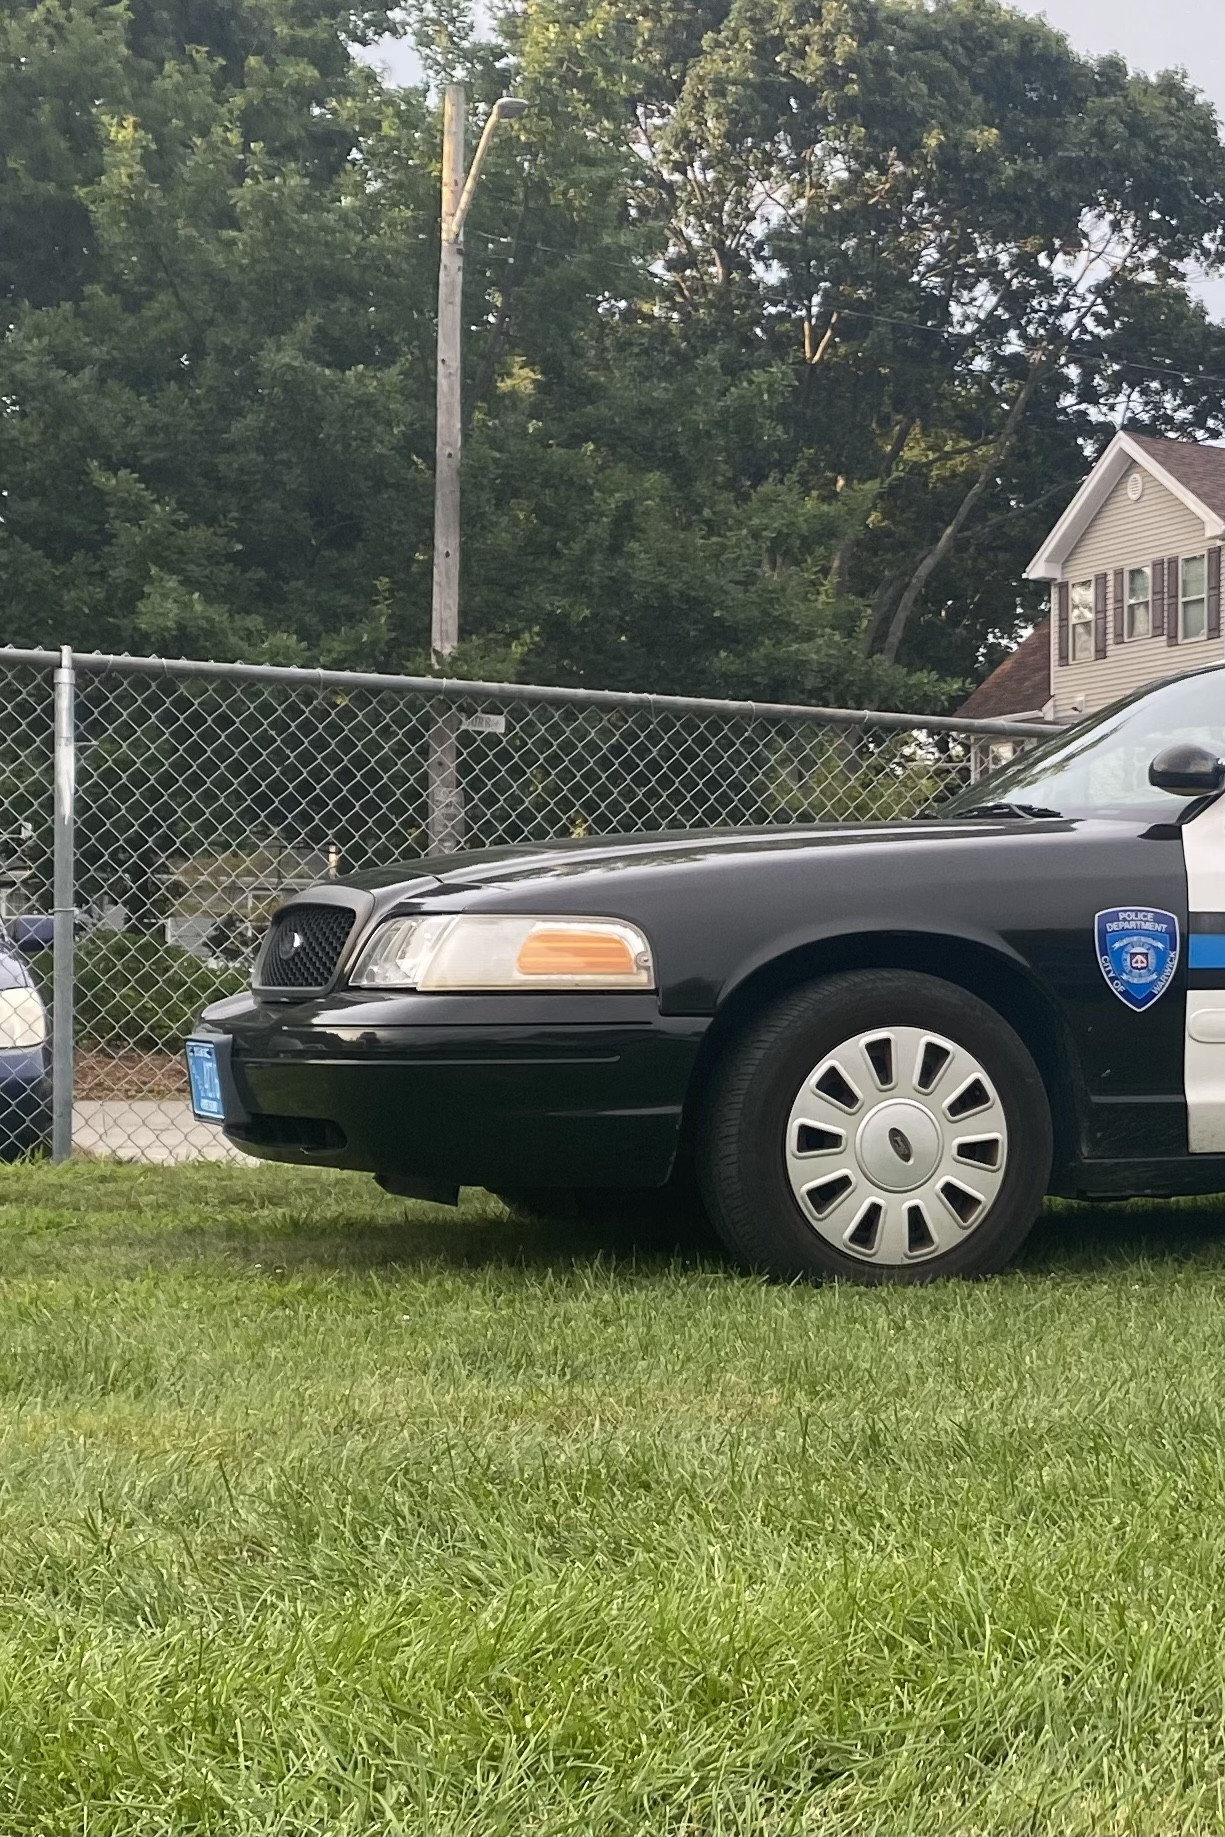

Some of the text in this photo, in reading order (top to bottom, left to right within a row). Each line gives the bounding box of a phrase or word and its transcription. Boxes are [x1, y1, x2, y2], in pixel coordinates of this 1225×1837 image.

[1119, 912, 1153, 921] POLICE
[1106, 921, 1168, 933] DEPARTMENT
[1101, 956, 1115, 979] CITY
[1113, 981, 1125, 992] OF
[1152, 951, 1176, 994] WARWICK
